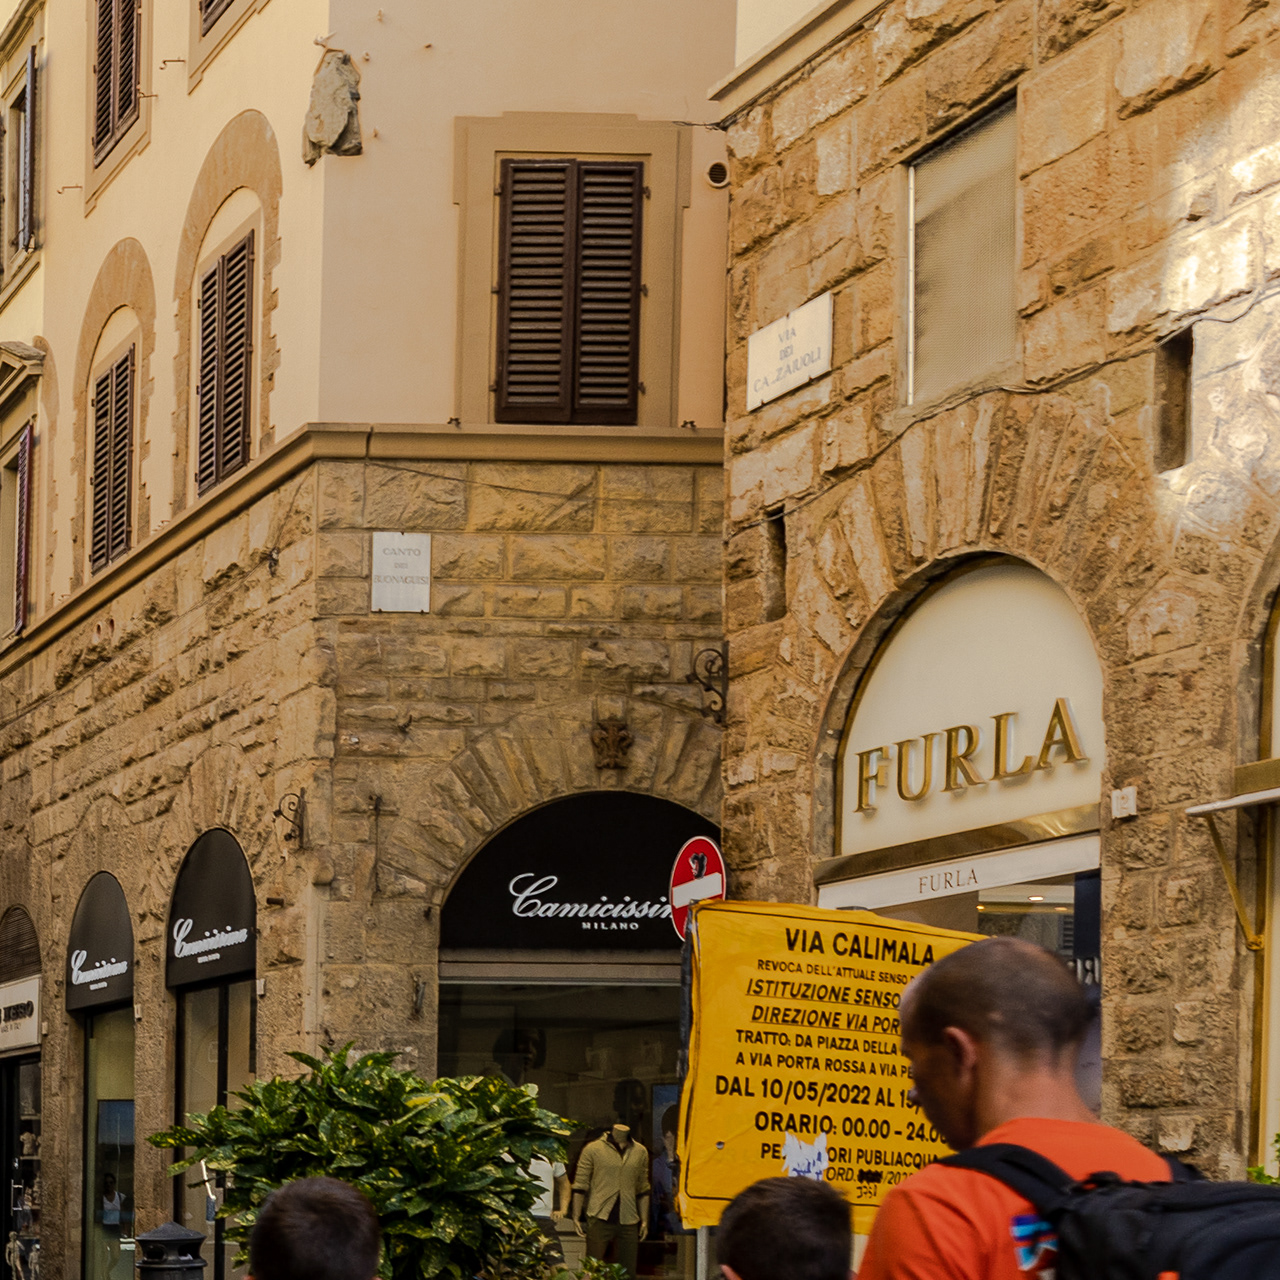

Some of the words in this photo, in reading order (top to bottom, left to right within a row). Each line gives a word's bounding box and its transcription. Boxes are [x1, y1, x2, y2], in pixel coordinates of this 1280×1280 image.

[778, 327, 797, 342] VIA
[383, 548, 421, 557] CANTO
[852, 697, 1090, 813] FURLA
[919, 868, 978, 893] FURLA
[508, 872, 673, 918] Camicissi
[582, 922, 639, 931] MILANO
[786, 927, 825, 954] VIA
[832, 932, 935, 967] CALIMALA
[757, 959, 803, 974] REVOCA
[806, 964, 875, 982] DELL'ATTUALE
[878, 971, 908, 985] SENSO
[747, 978, 851, 1003] ISTITUZIONE
[853, 988, 901, 1009] SENSO
[751, 1005, 842, 1029] DIREZIONE
[845, 1013, 869, 1032] VIA
[736, 1029, 791, 1046] TRATTO:
[795, 1034, 813, 1048] DA
[817, 1036, 859, 1052] PIAZZA
[863, 1040, 898, 1056] DELLA
[736, 1052, 745, 1065] A
[750, 1053, 772, 1067] VIA
[777, 1055, 820, 1070] PORTA
[825, 1058, 866, 1074] ROSSA
[869, 1062, 877, 1075] A
[879, 1063, 898, 1077] VIA
[715, 1075, 755, 1097] DAL
[761, 1078, 871, 1107] 10/05/2022
[874, 1087, 896, 1108] AL
[754, 1111, 837, 1135] ORARIO:
[842, 1117, 890, 1139] 00.00
[761, 1143, 786, 1160] PE
